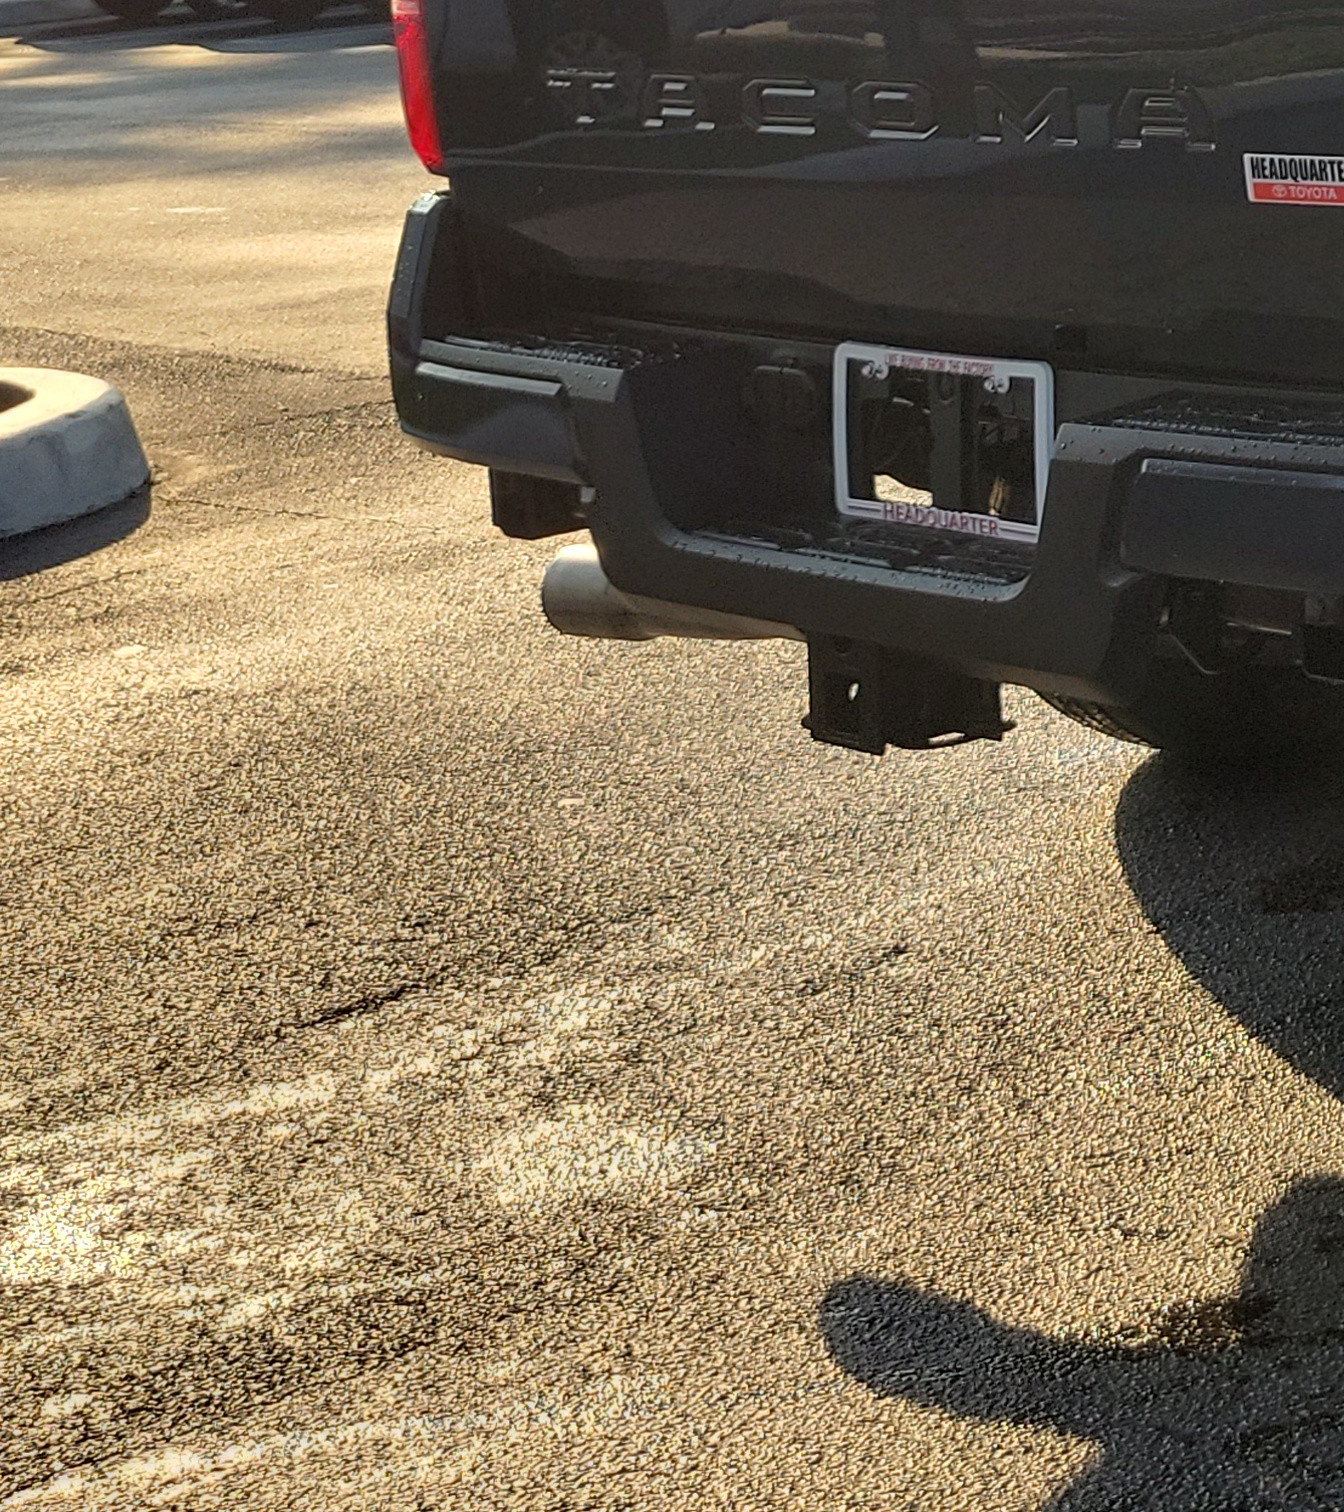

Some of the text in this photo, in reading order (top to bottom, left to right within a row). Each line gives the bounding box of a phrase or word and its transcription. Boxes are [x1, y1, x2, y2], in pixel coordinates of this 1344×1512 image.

[546, 69, 1216, 151] TACOMA
[1289, 185, 1338, 200] TOYOTA
[884, 501, 999, 536] HEADQUARTER
